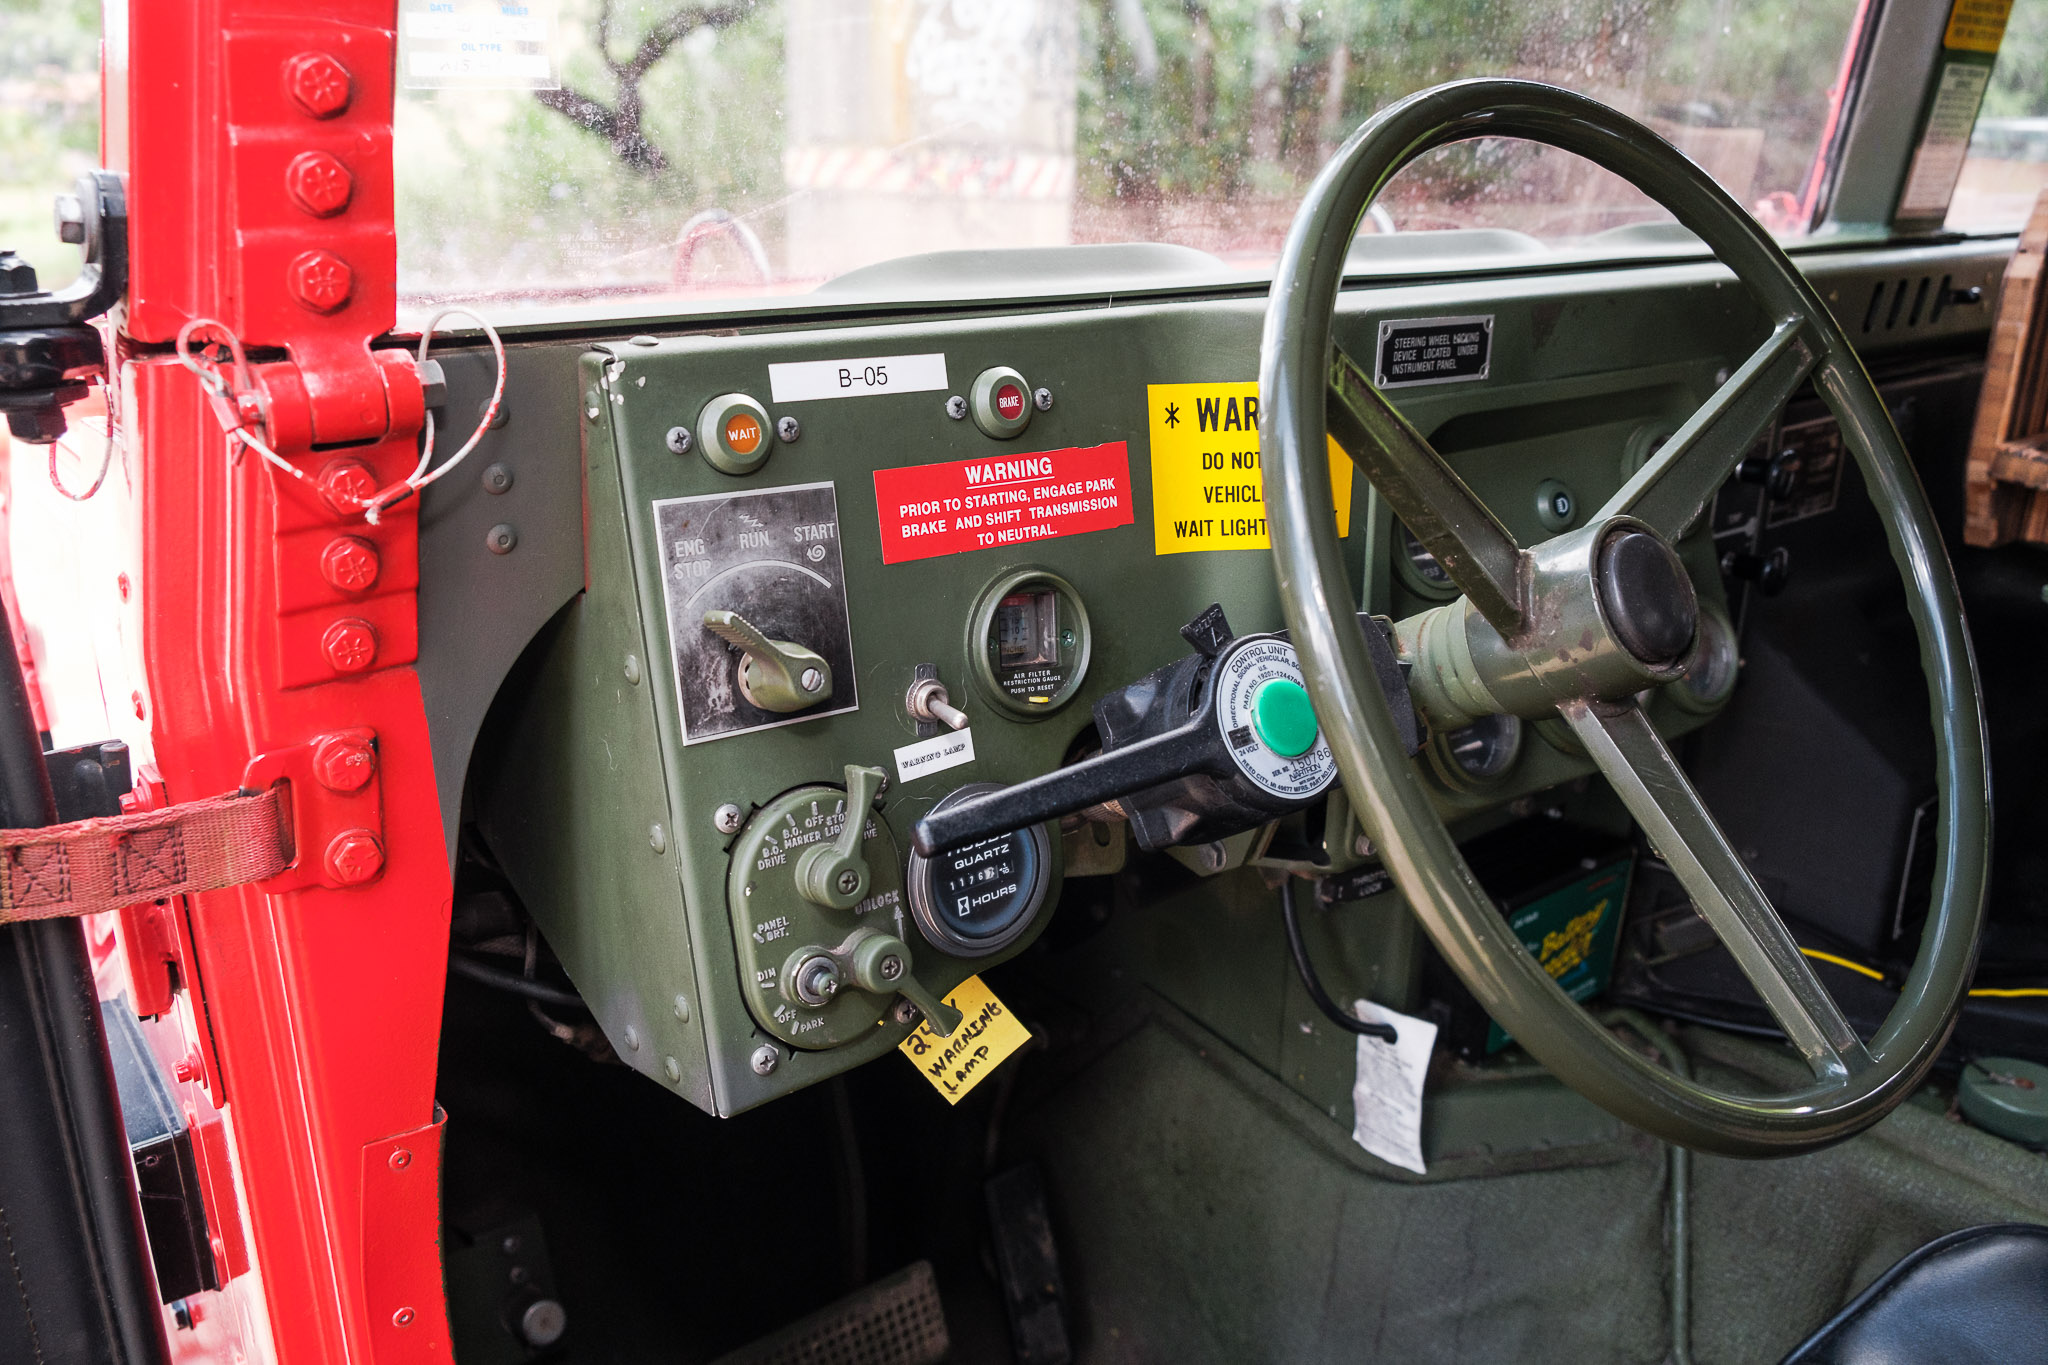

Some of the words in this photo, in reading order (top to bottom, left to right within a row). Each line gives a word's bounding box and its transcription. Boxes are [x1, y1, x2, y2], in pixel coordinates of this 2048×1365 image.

[429, 3, 454, 13] DATE
[461, 43, 476, 52] OIL
[479, 43, 503, 52] TYPE
[1394, 335, 1427, 349] STEERING
[1428, 334, 1451, 346] WHEEL
[1393, 349, 1417, 362] DEVICE
[1423, 346, 1452, 359] LOCATED
[1457, 344, 1479, 356] UNDER
[838, 365, 888, 388] B-05
[1392, 361, 1435, 375] INSTRUMENT
[1436, 359, 1457, 370] PANEL
[999, 395, 1020, 408] BRAKE
[1196, 396, 1260, 433] WAR
[727, 426, 757, 441] WAIT
[1202, 451, 1224, 470] DO
[964, 457, 1053, 485] WARNING
[899, 501, 941, 518] PRIOR
[943, 498, 961, 512] TO
[964, 489, 1031, 510] STARTING,
[1033, 481, 1083, 500] ENGAGE
[1086, 477, 1116, 493] PARK
[1203, 484, 1265, 504] VEHICL
[901, 519, 947, 538] BRAKE
[955, 514, 983, 531] AND
[986, 509, 1022, 527] SHIFT
[1028, 495, 1118, 520] TRANSMISSION
[793, 522, 835, 543] START
[976, 532, 994, 546] TO
[998, 523, 1058, 543] NEUTRAL.
[1174, 519, 1214, 539] WAIT
[1220, 518, 1268, 537] LIGHT
[674, 538, 706, 558] ENG
[739, 530, 770, 550] RUN
[673, 559, 712, 580] STOP
[1011, 626, 1020, 635] 10
[1231, 646, 1267, 674] CONTROL
[1267, 645, 1288, 657] UNIT
[919, 667, 935, 678] ON
[1003, 677, 1041, 686] RESTRICTION
[1013, 671, 1025, 680] AIR
[1028, 669, 1051, 678] FILTER
[1010, 686, 1026, 694] PUSH
[1037, 683, 1055, 691] RESET
[1229, 681, 1241, 729] DIRECTIONAL
[1291, 661, 1302, 672] SO
[1243, 689, 1252, 710] PART
[901, 751, 942, 769] WARNING
[943, 743, 966, 756] LAMP
[1245, 743, 1260, 754] VOLT
[1290, 747, 1331, 773] 150786
[1242, 759, 1256, 775] REED
[1309, 777, 1322, 788] PART
[1289, 762, 1322, 783] NARTRON
[804, 814, 824, 828] OFF
[826, 811, 848, 826] STO
[782, 826, 802, 839] B.O.
[784, 831, 822, 850] MARKER
[863, 828, 878, 840] IVE
[762, 845, 783, 858] B.O.
[954, 843, 1010, 870] QUARTZ
[757, 853, 787, 871] DRIVE
[855, 889, 900, 915] UNLOCK
[972, 883, 1017, 907] HOURS
[757, 916, 790, 934] PANEL
[757, 967, 777, 982] DIM
[778, 1009, 797, 1024] OFF
[800, 1017, 825, 1033] PARK
[928, 1002, 1003, 1078] WARNING
[943, 1045, 989, 1095] LAMP
